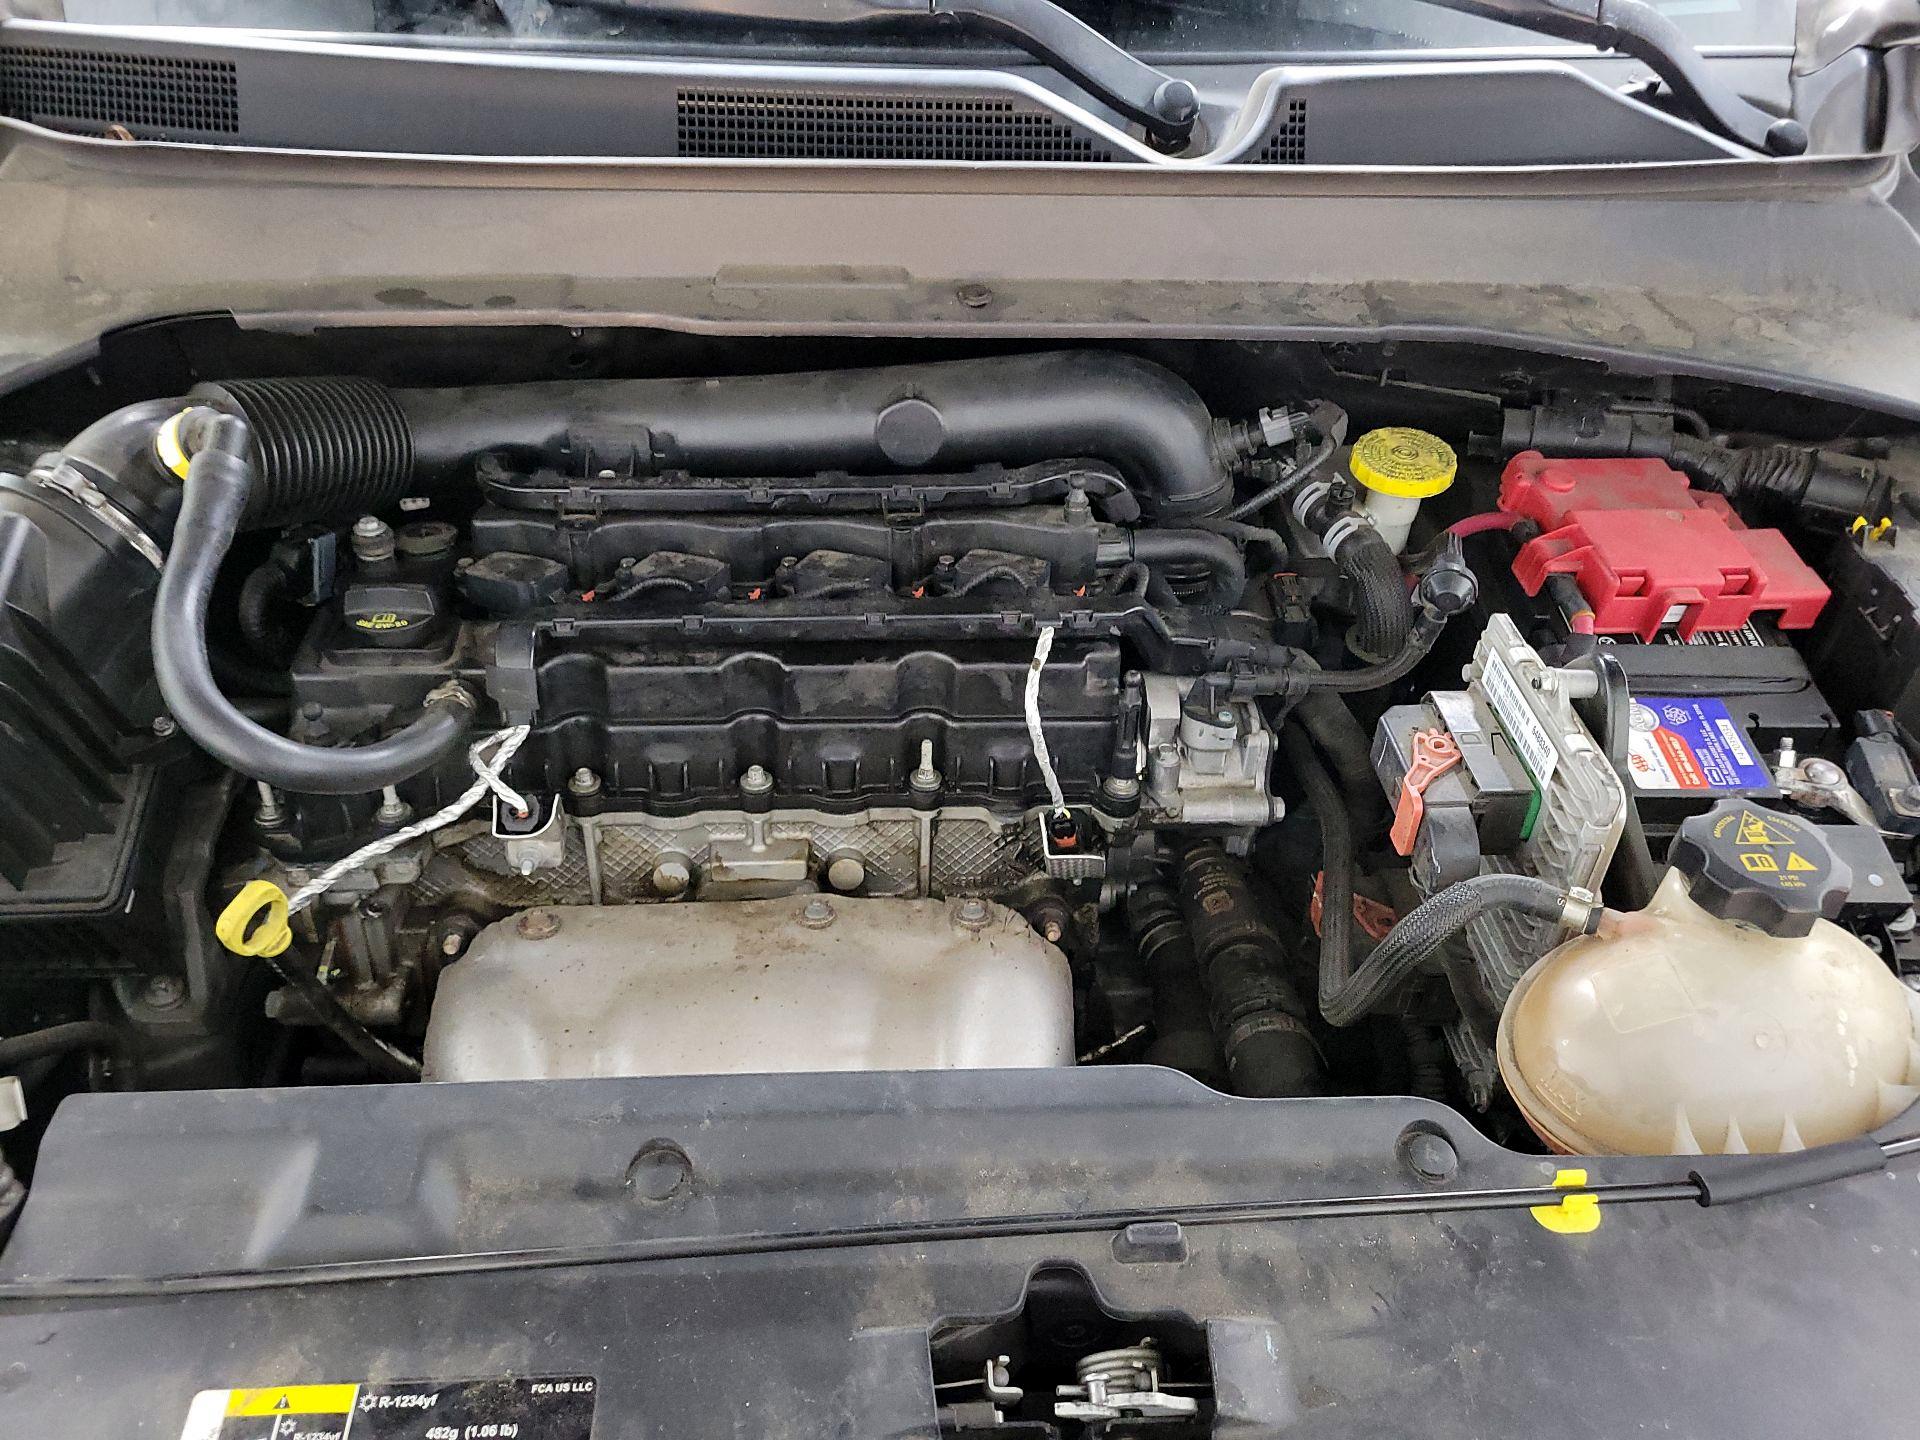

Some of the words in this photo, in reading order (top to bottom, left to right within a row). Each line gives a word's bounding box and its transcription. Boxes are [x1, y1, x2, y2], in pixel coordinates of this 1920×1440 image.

[531, 1383, 551, 1394] FCA
[555, 1383, 570, 1393] US
[573, 1382, 594, 1392] LLC
[378, 1394, 439, 1410] R-1234yf
[425, 1427, 459, 1440] 482g
[465, 1425, 498, 1440] (1.06
[499, 1423, 519, 1438] lb)
